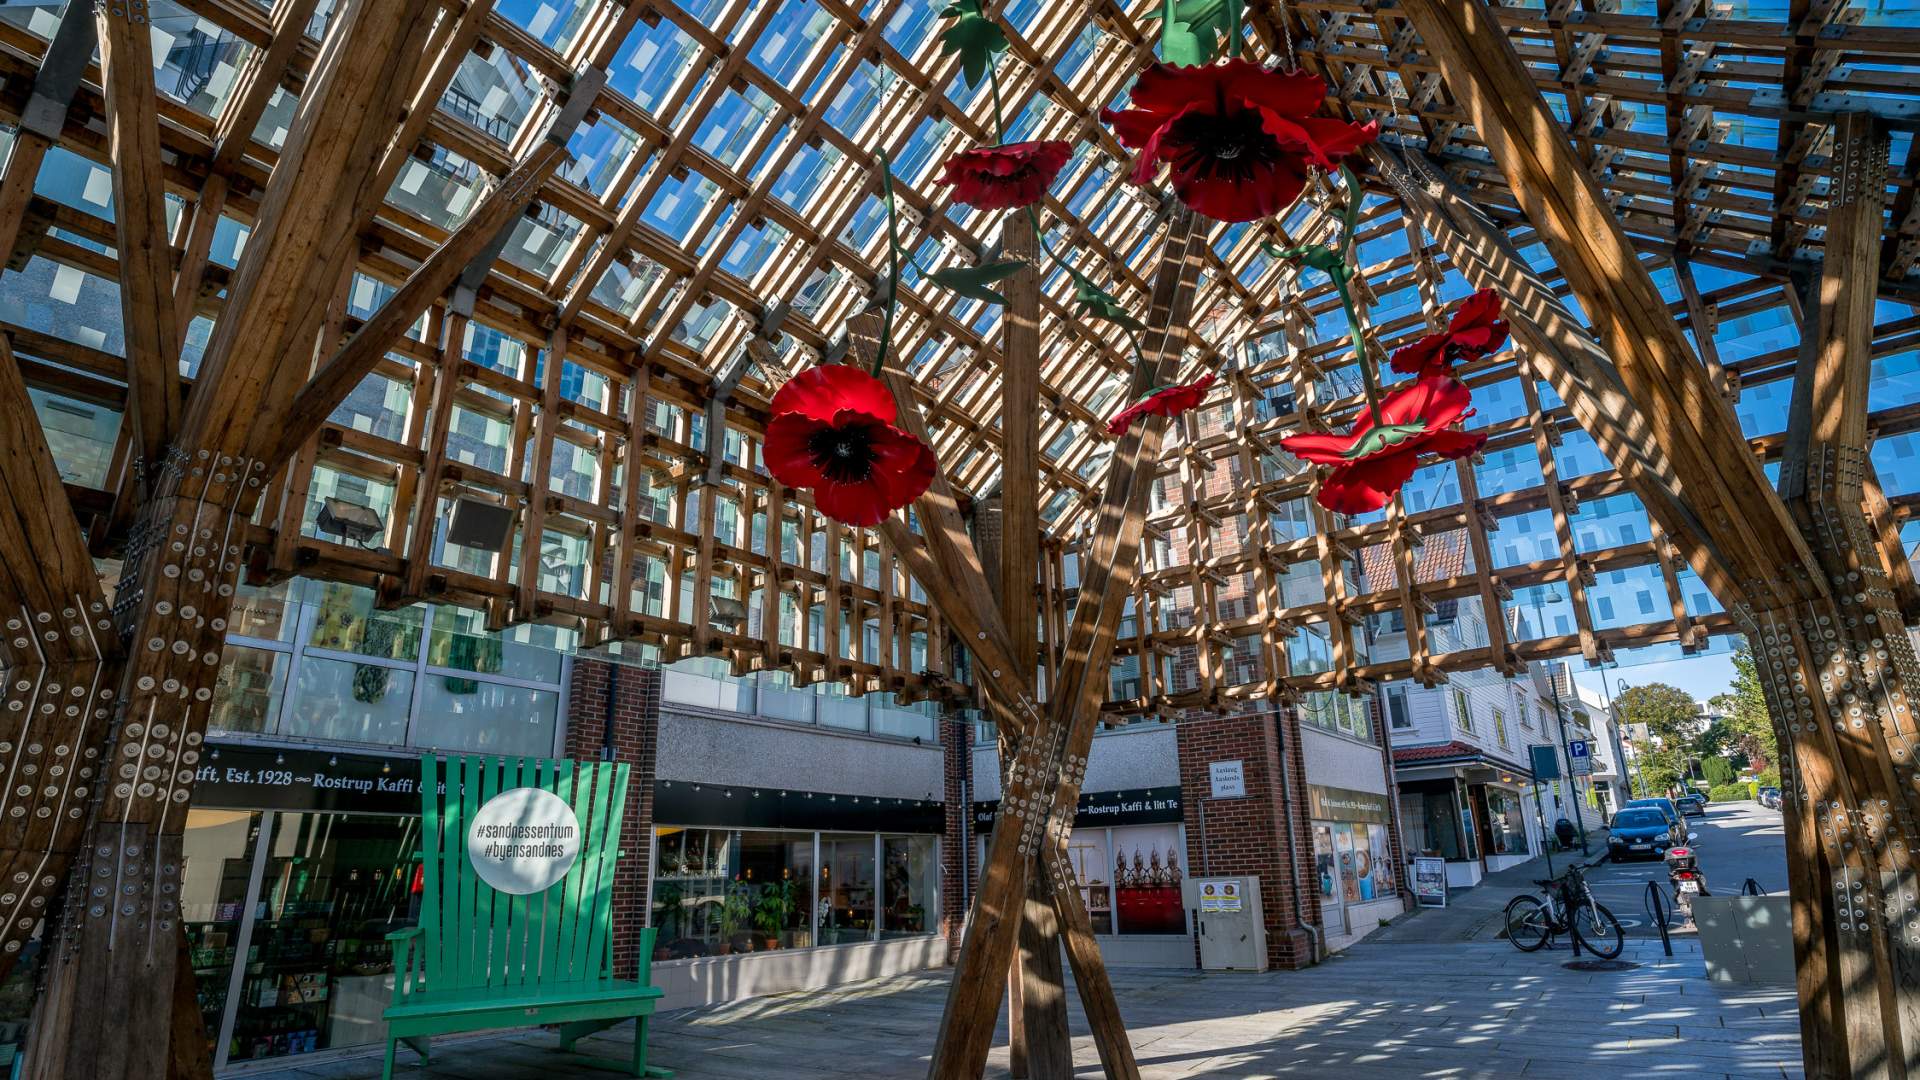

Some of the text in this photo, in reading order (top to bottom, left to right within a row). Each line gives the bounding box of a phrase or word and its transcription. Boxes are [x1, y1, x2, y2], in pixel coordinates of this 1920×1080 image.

[1574, 743, 1583, 755] P
[226, 767, 255, 783] Est.
[257, 769, 292, 786] 1928
[312, 773, 374, 794] Rostrup
[376, 777, 413, 793] Kaffi
[1088, 804, 1119, 816] Rostrup
[1121, 801, 1142, 812] Kaffi
[1145, 800, 1153, 810] &
[1167, 799, 1178, 809] Te
[477, 822, 573, 839] #sandnessentrum
[484, 841, 564, 861] #byensandnes
